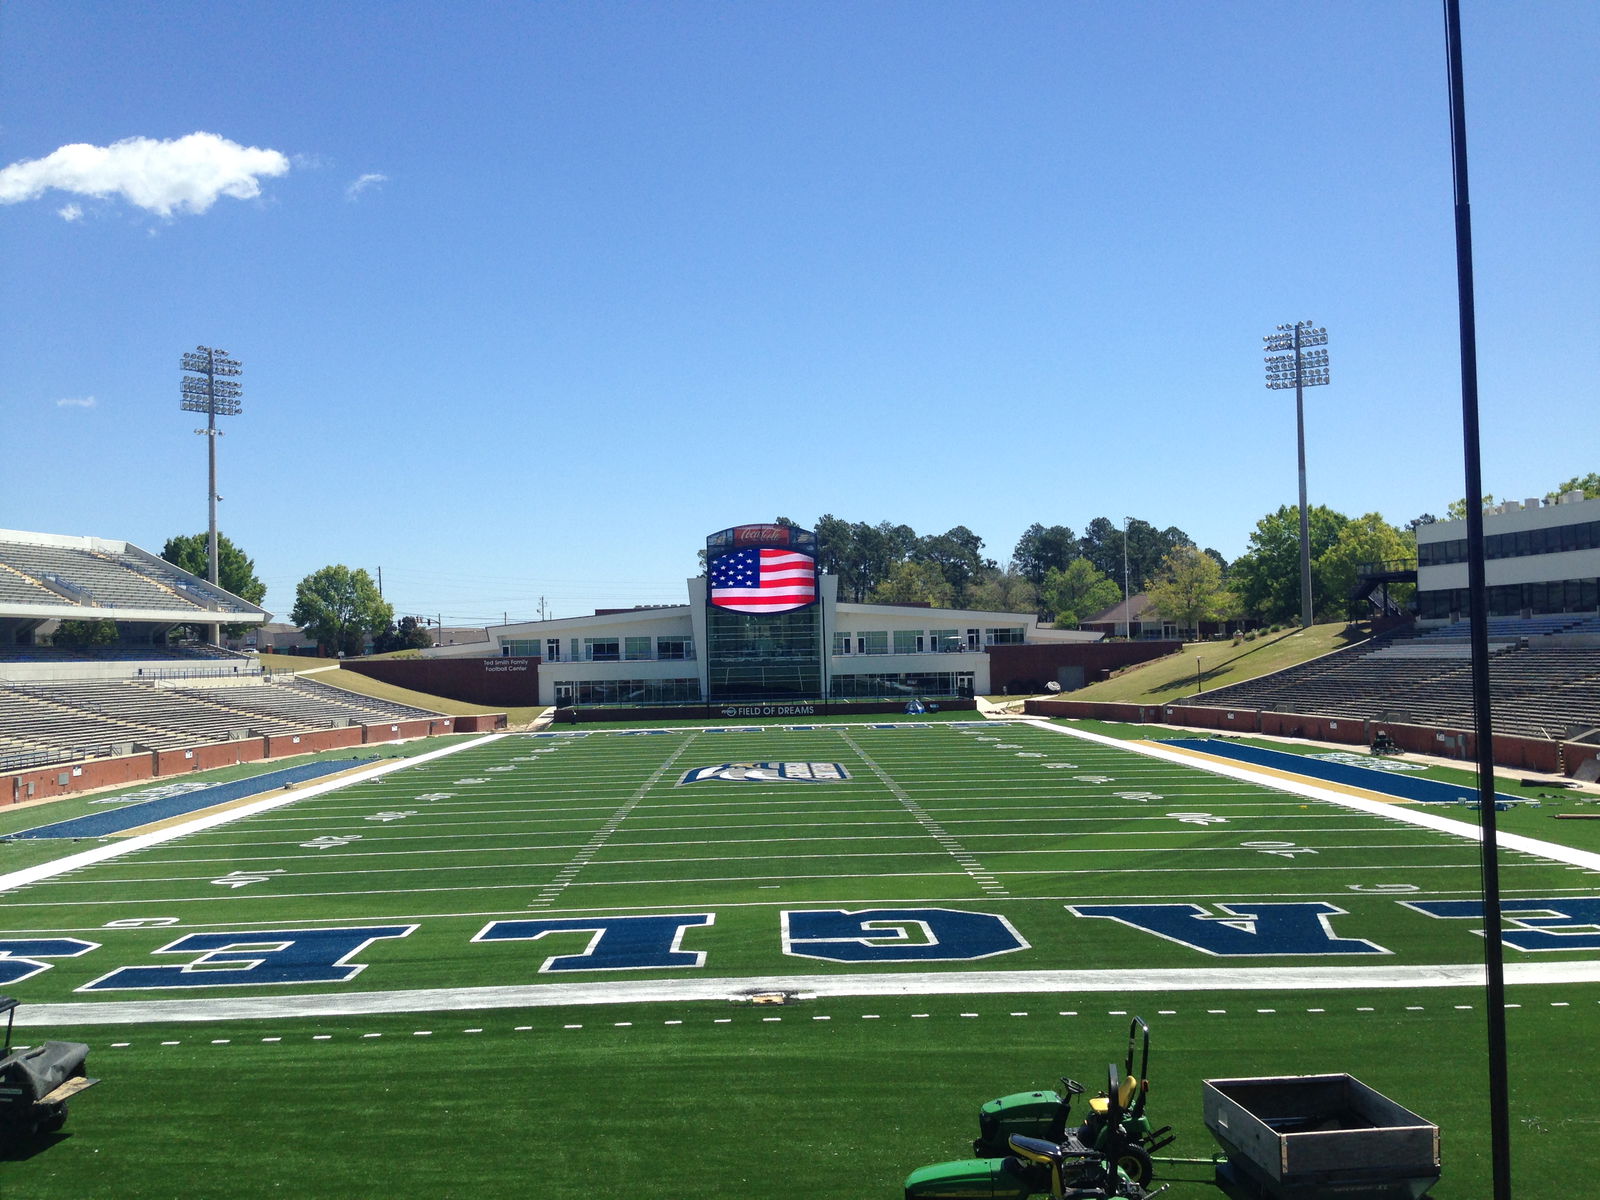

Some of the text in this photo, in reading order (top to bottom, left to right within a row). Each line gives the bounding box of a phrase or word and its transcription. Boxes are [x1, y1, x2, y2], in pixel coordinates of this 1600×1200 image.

[738, 707, 761, 716] FIELD
[762, 707, 775, 715] OF
[777, 706, 815, 715] DREAMS
